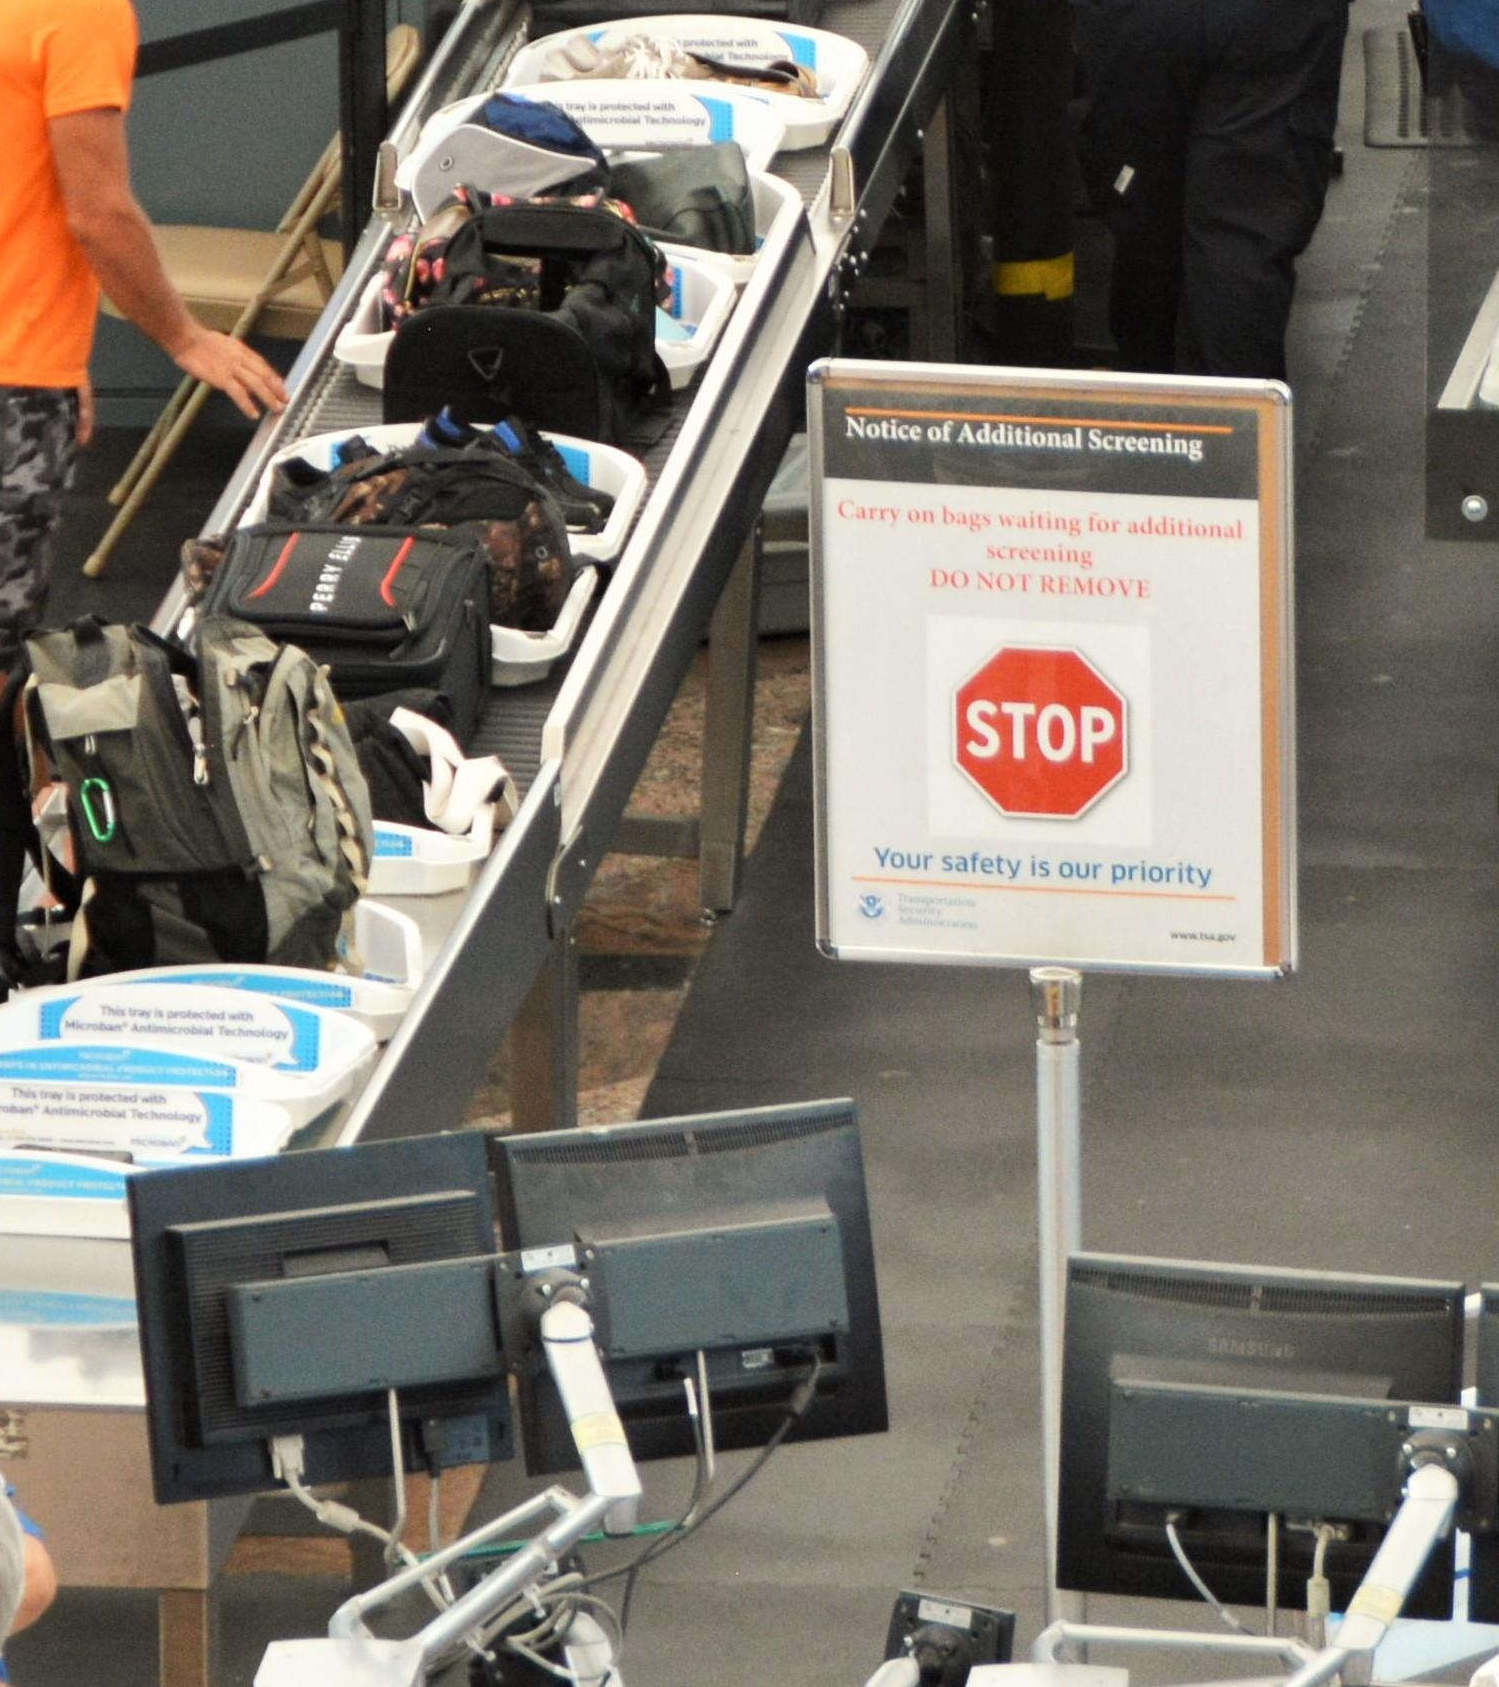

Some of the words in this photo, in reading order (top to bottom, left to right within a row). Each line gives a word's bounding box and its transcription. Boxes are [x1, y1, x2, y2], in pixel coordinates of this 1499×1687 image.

[682, 38, 734, 50] protected
[735, 37, 758, 48] with
[565, 102, 586, 114] tray
[588, 101, 598, 112] is
[599, 101, 651, 114] protected
[652, 101, 676, 112] with
[845, 416, 923, 441] Notice
[926, 421, 954, 443] of
[958, 424, 1082, 449] Additional
[1087, 429, 1204, 460] Screening
[836, 499, 900, 524] Carry
[906, 508, 935, 524] on
[943, 505, 992, 532] bags
[998, 511, 1082, 537] waiting
[1087, 513, 1120, 534] for
[1127, 517, 1244, 540] additional
[328, 535, 362, 562] ELLIS
[986, 544, 1094, 568] screening
[309, 563, 343, 611] PERRY
[929, 569, 970, 589] DO
[977, 572, 1032, 593] NOT
[1039, 575, 1151, 600] REMOVE
[964, 699, 1116, 764] STOP
[874, 847, 933, 872] Your
[941, 852, 1022, 880] safety
[1030, 854, 1051, 878] is
[1058, 861, 1103, 880] our
[1110, 860, 1213, 889] priority
[897, 893, 977, 908] Transportation
[897, 905, 942, 918] Security
[897, 916, 979, 930] Administration
[1170, 931, 1236, 943] www.tsa.gov
[100, 1005, 126, 1018] This
[128, 1007, 152, 1021] tray
[154, 1006, 164, 1019] is
[166, 1007, 225, 1022] protected
[227, 1010, 254, 1023] with
[130, 1023, 214, 1037] Antimicrobial
[218, 1025, 290, 1041] Technology
[10, 1087, 37, 1101] This
[39, 1089, 64, 1103] tray
[66, 1088, 76, 1101] is
[78, 1090, 139, 1105] protected
[140, 1092, 167, 1105] with
[42, 1106, 127, 1120] Antimicrobial
[131, 1108, 202, 1125] Technology
